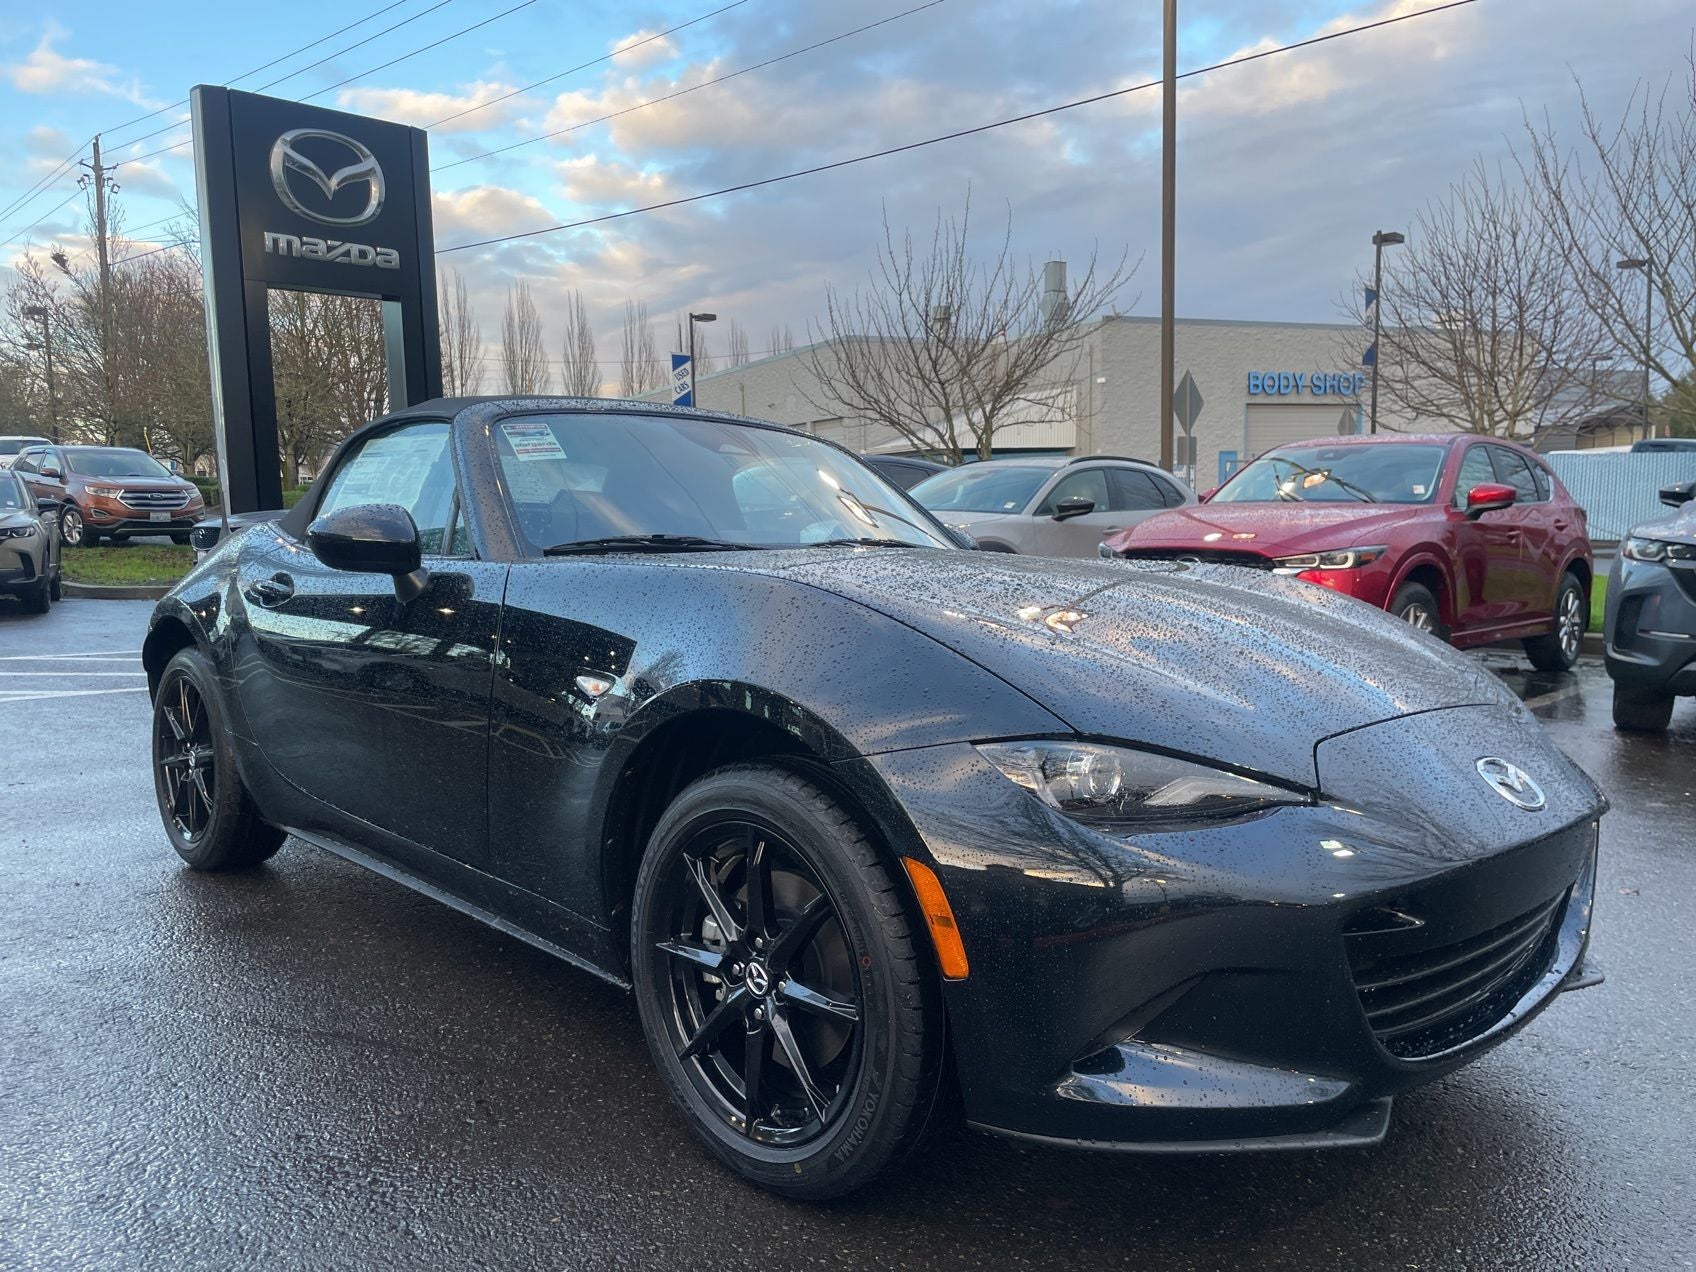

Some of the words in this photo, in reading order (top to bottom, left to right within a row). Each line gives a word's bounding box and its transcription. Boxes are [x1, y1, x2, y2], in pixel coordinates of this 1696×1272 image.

[674, 367, 690, 381] USED
[1248, 370, 1306, 396] BODY
[1311, 371, 1366, 396] SHOP
[674, 381, 690, 395] CARS
[834, 1092, 880, 1162] YOKOHAMA
